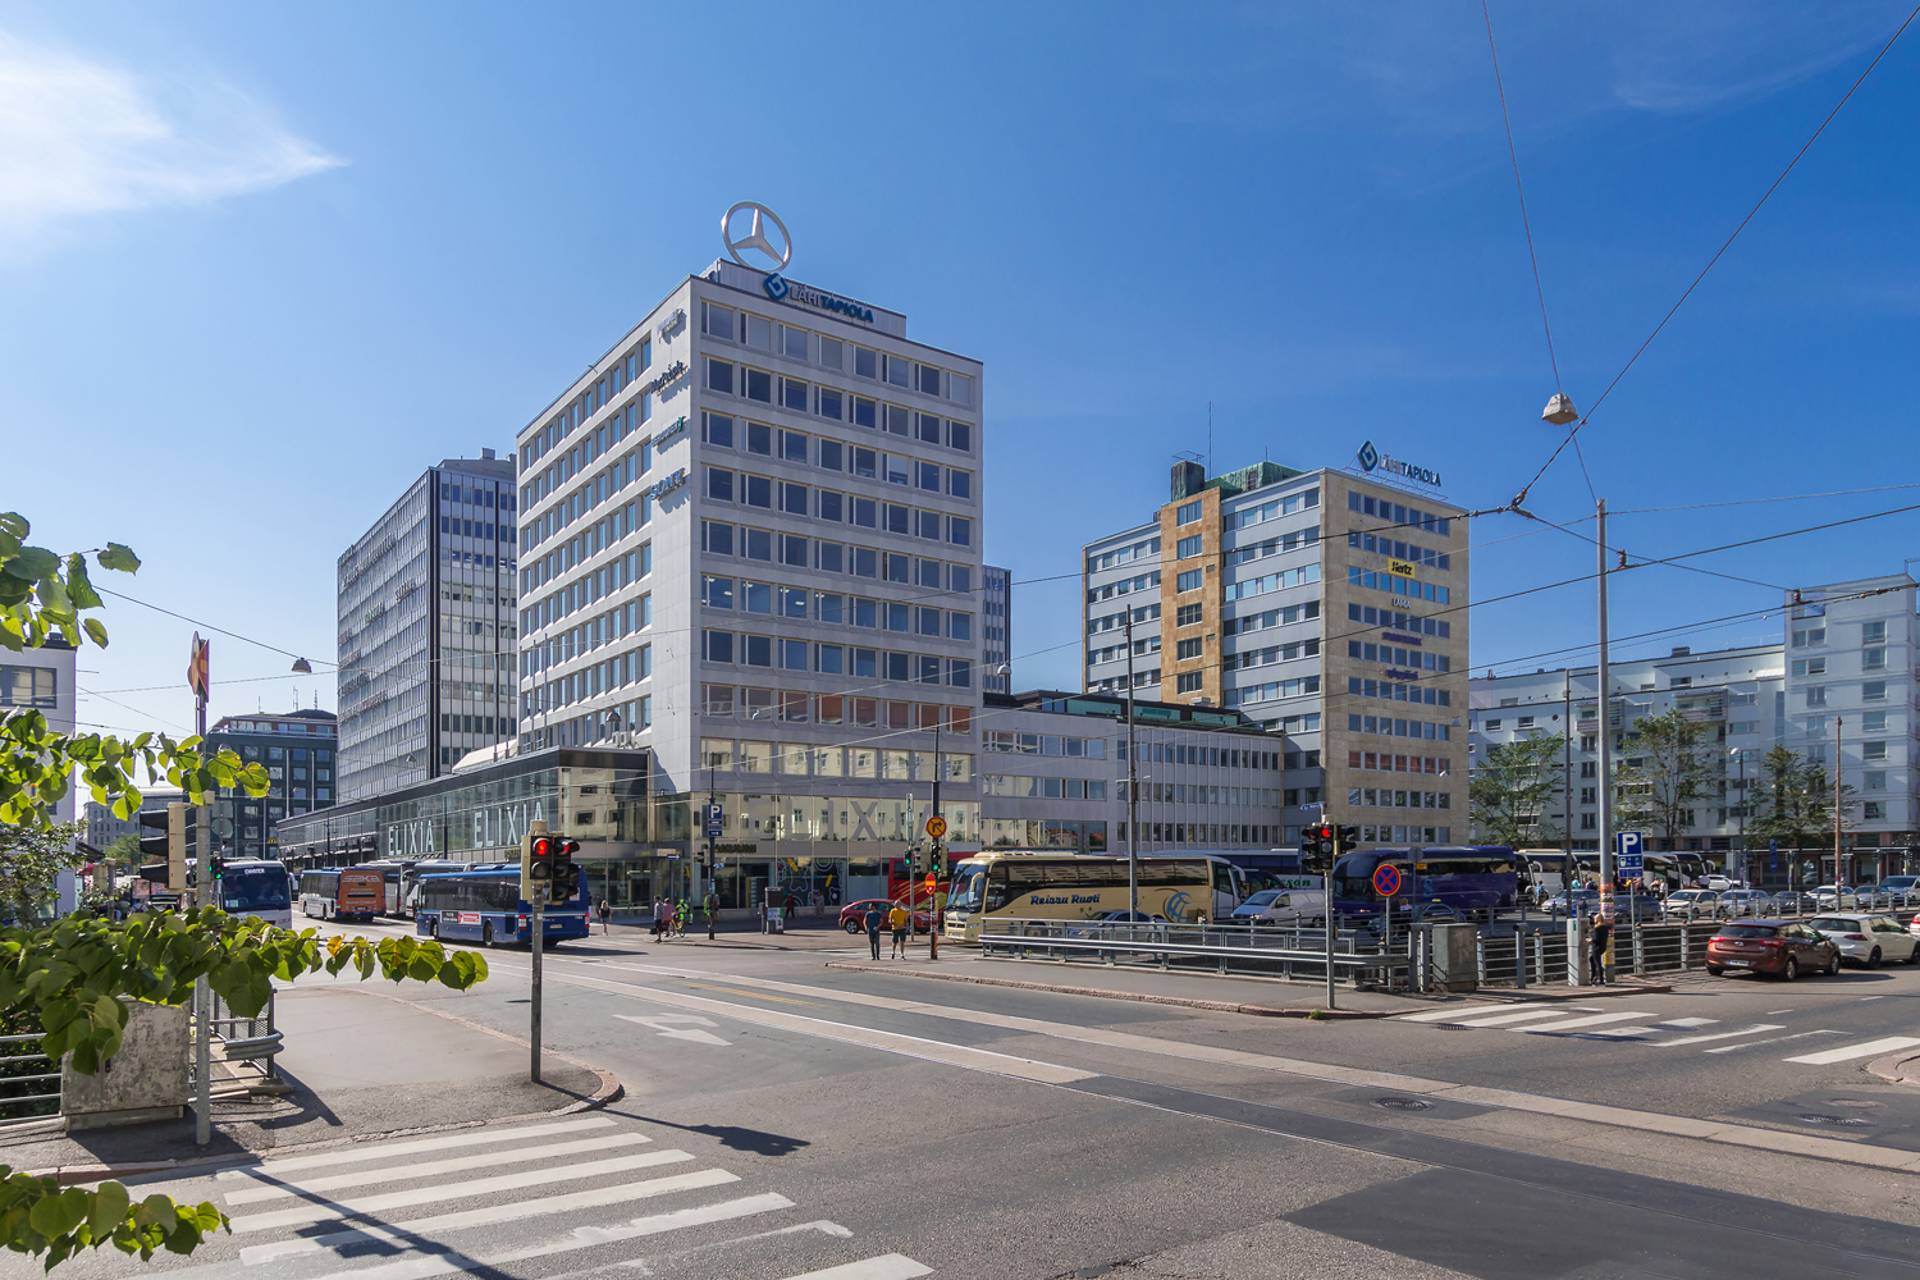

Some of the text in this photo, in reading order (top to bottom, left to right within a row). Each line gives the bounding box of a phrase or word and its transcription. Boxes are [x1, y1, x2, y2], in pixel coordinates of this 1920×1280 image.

[1392, 561, 1413, 576] Hertz
[711, 805, 720, 819] P
[388, 819, 435, 856] ELIXIA
[1622, 833, 1639, 854] P
[1071, 894, 1101, 904] Ruoti
